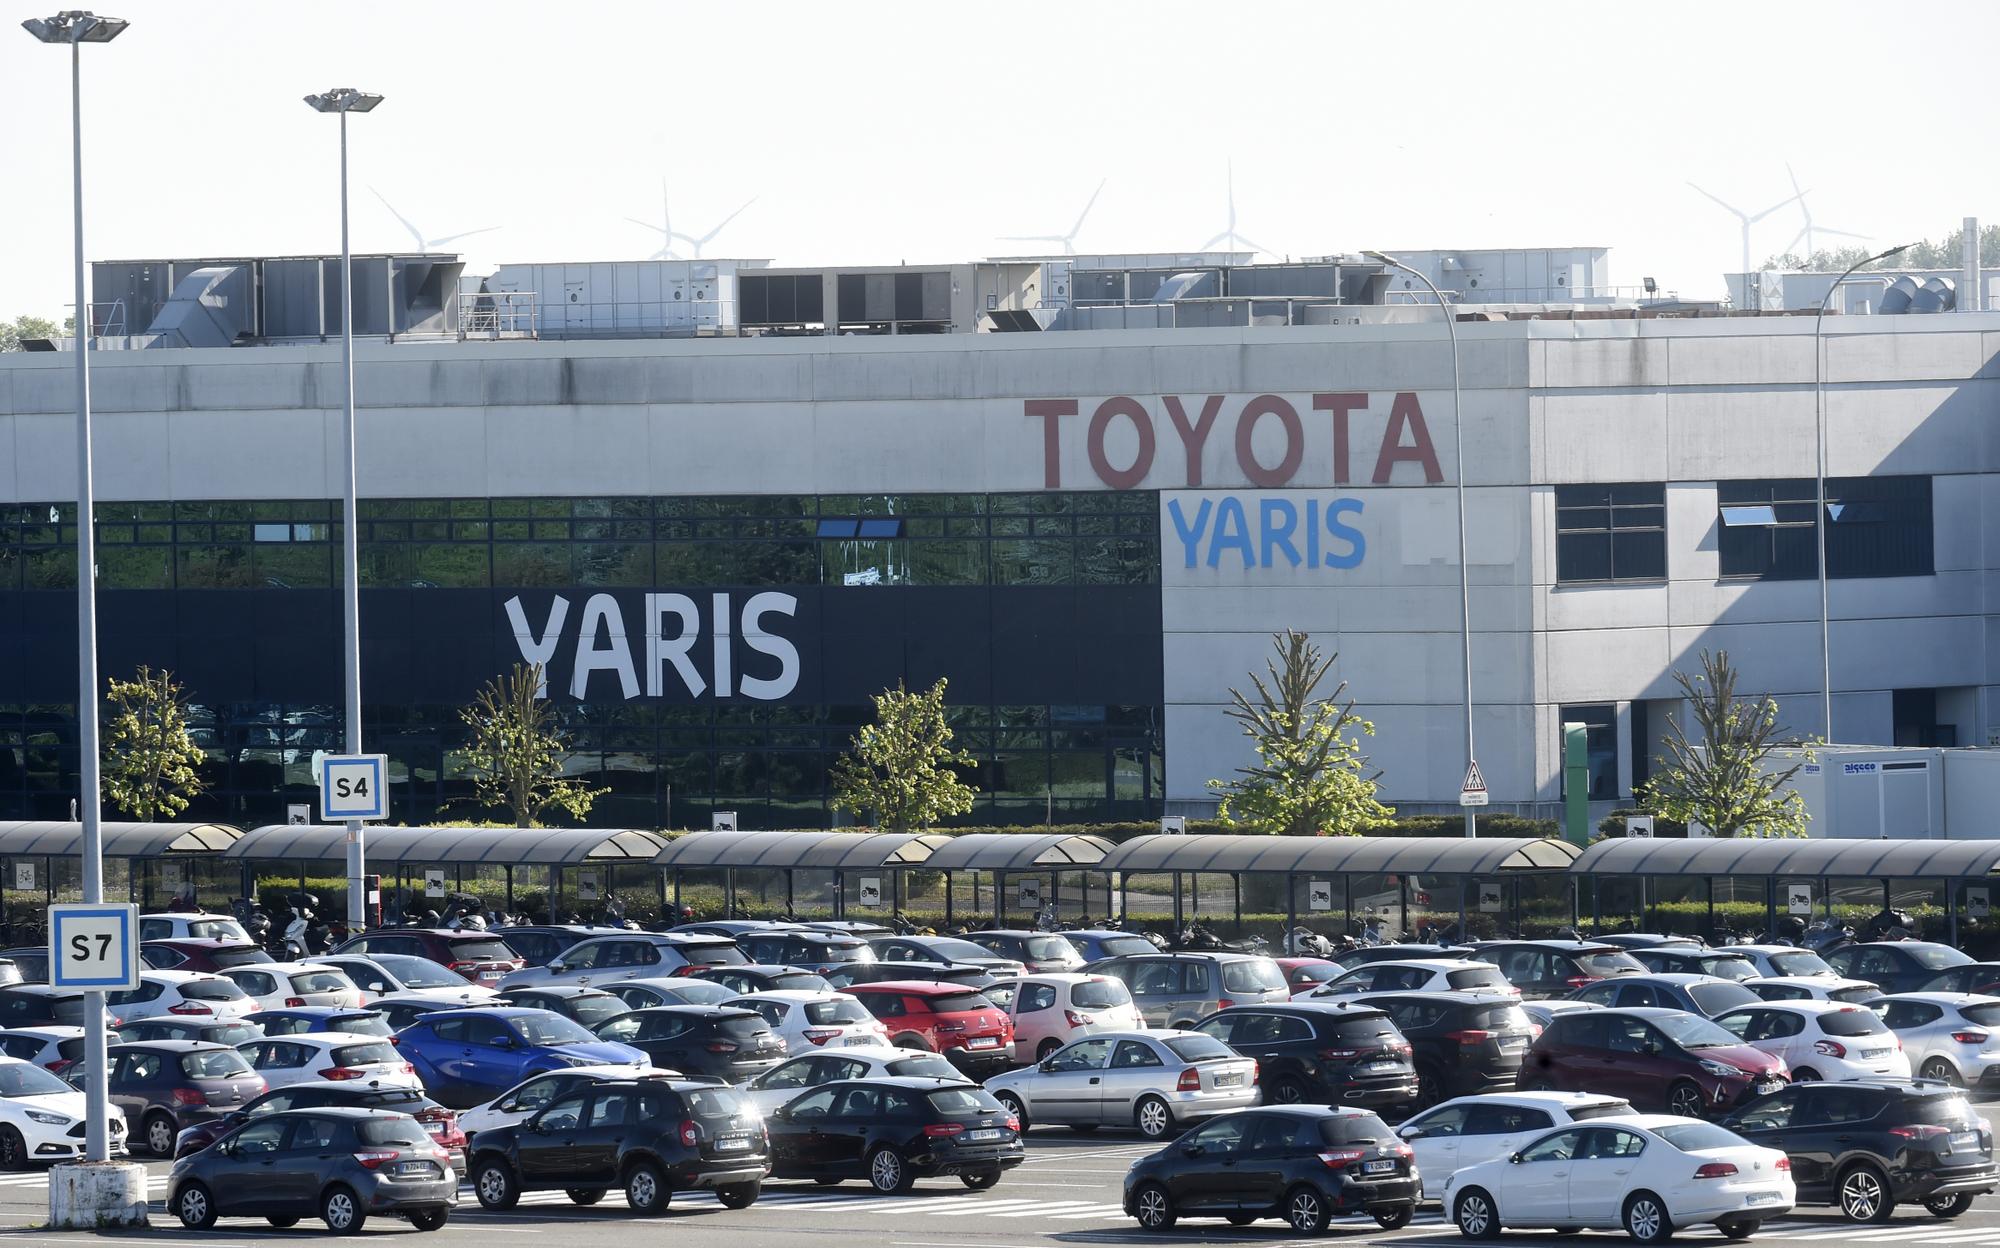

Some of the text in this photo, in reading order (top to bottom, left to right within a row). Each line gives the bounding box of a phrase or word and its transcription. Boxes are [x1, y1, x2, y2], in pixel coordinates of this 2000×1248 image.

[1024, 392, 1445, 490] TOYOTA
[1167, 496, 1366, 570] YARIS
[504, 591, 800, 700] YARIS
[336, 777, 368, 798] S4
[71, 933, 112, 962] S7
